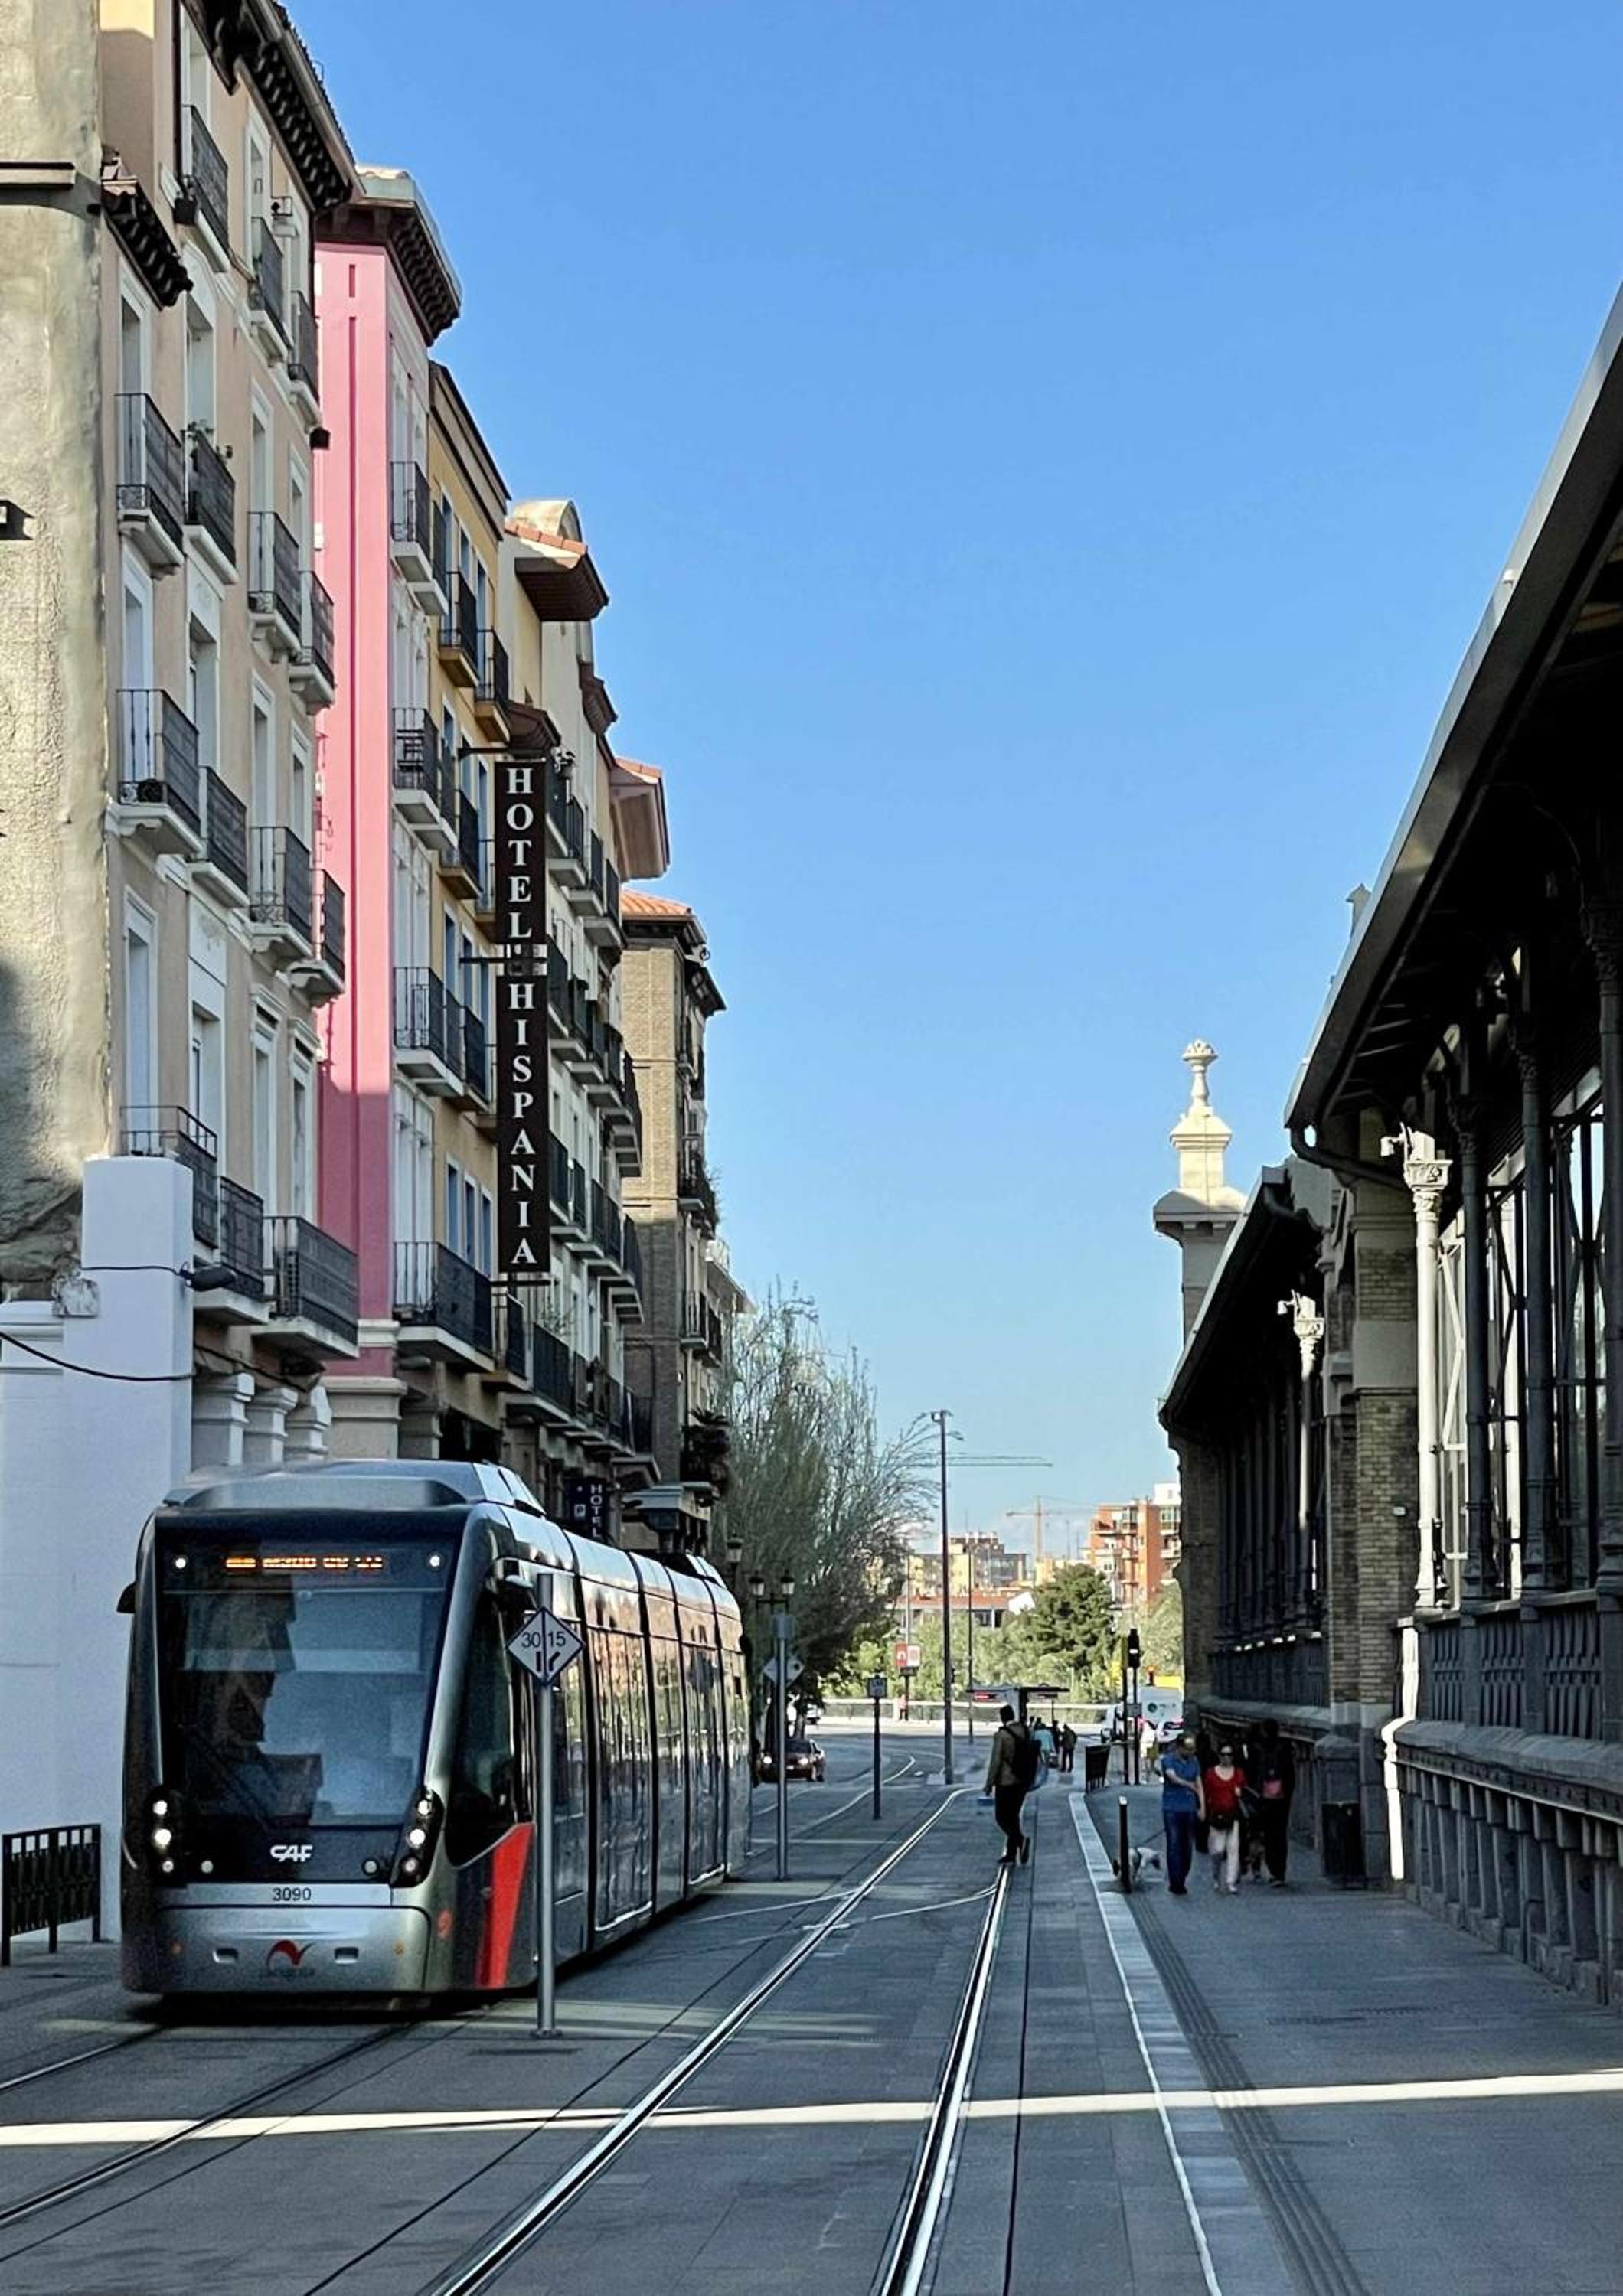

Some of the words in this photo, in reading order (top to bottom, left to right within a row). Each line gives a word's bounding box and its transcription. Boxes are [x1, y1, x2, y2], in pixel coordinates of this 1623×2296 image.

[506, 767, 534, 939] HOTEL
[508, 983, 538, 1264] HISPANIA
[590, 1484, 603, 1538] HOTEL
[521, 1631, 541, 1649] 30
[548, 1631, 566, 1648] 15
[269, 1844, 313, 1862] CAF
[272, 1887, 312, 1902] 3090
